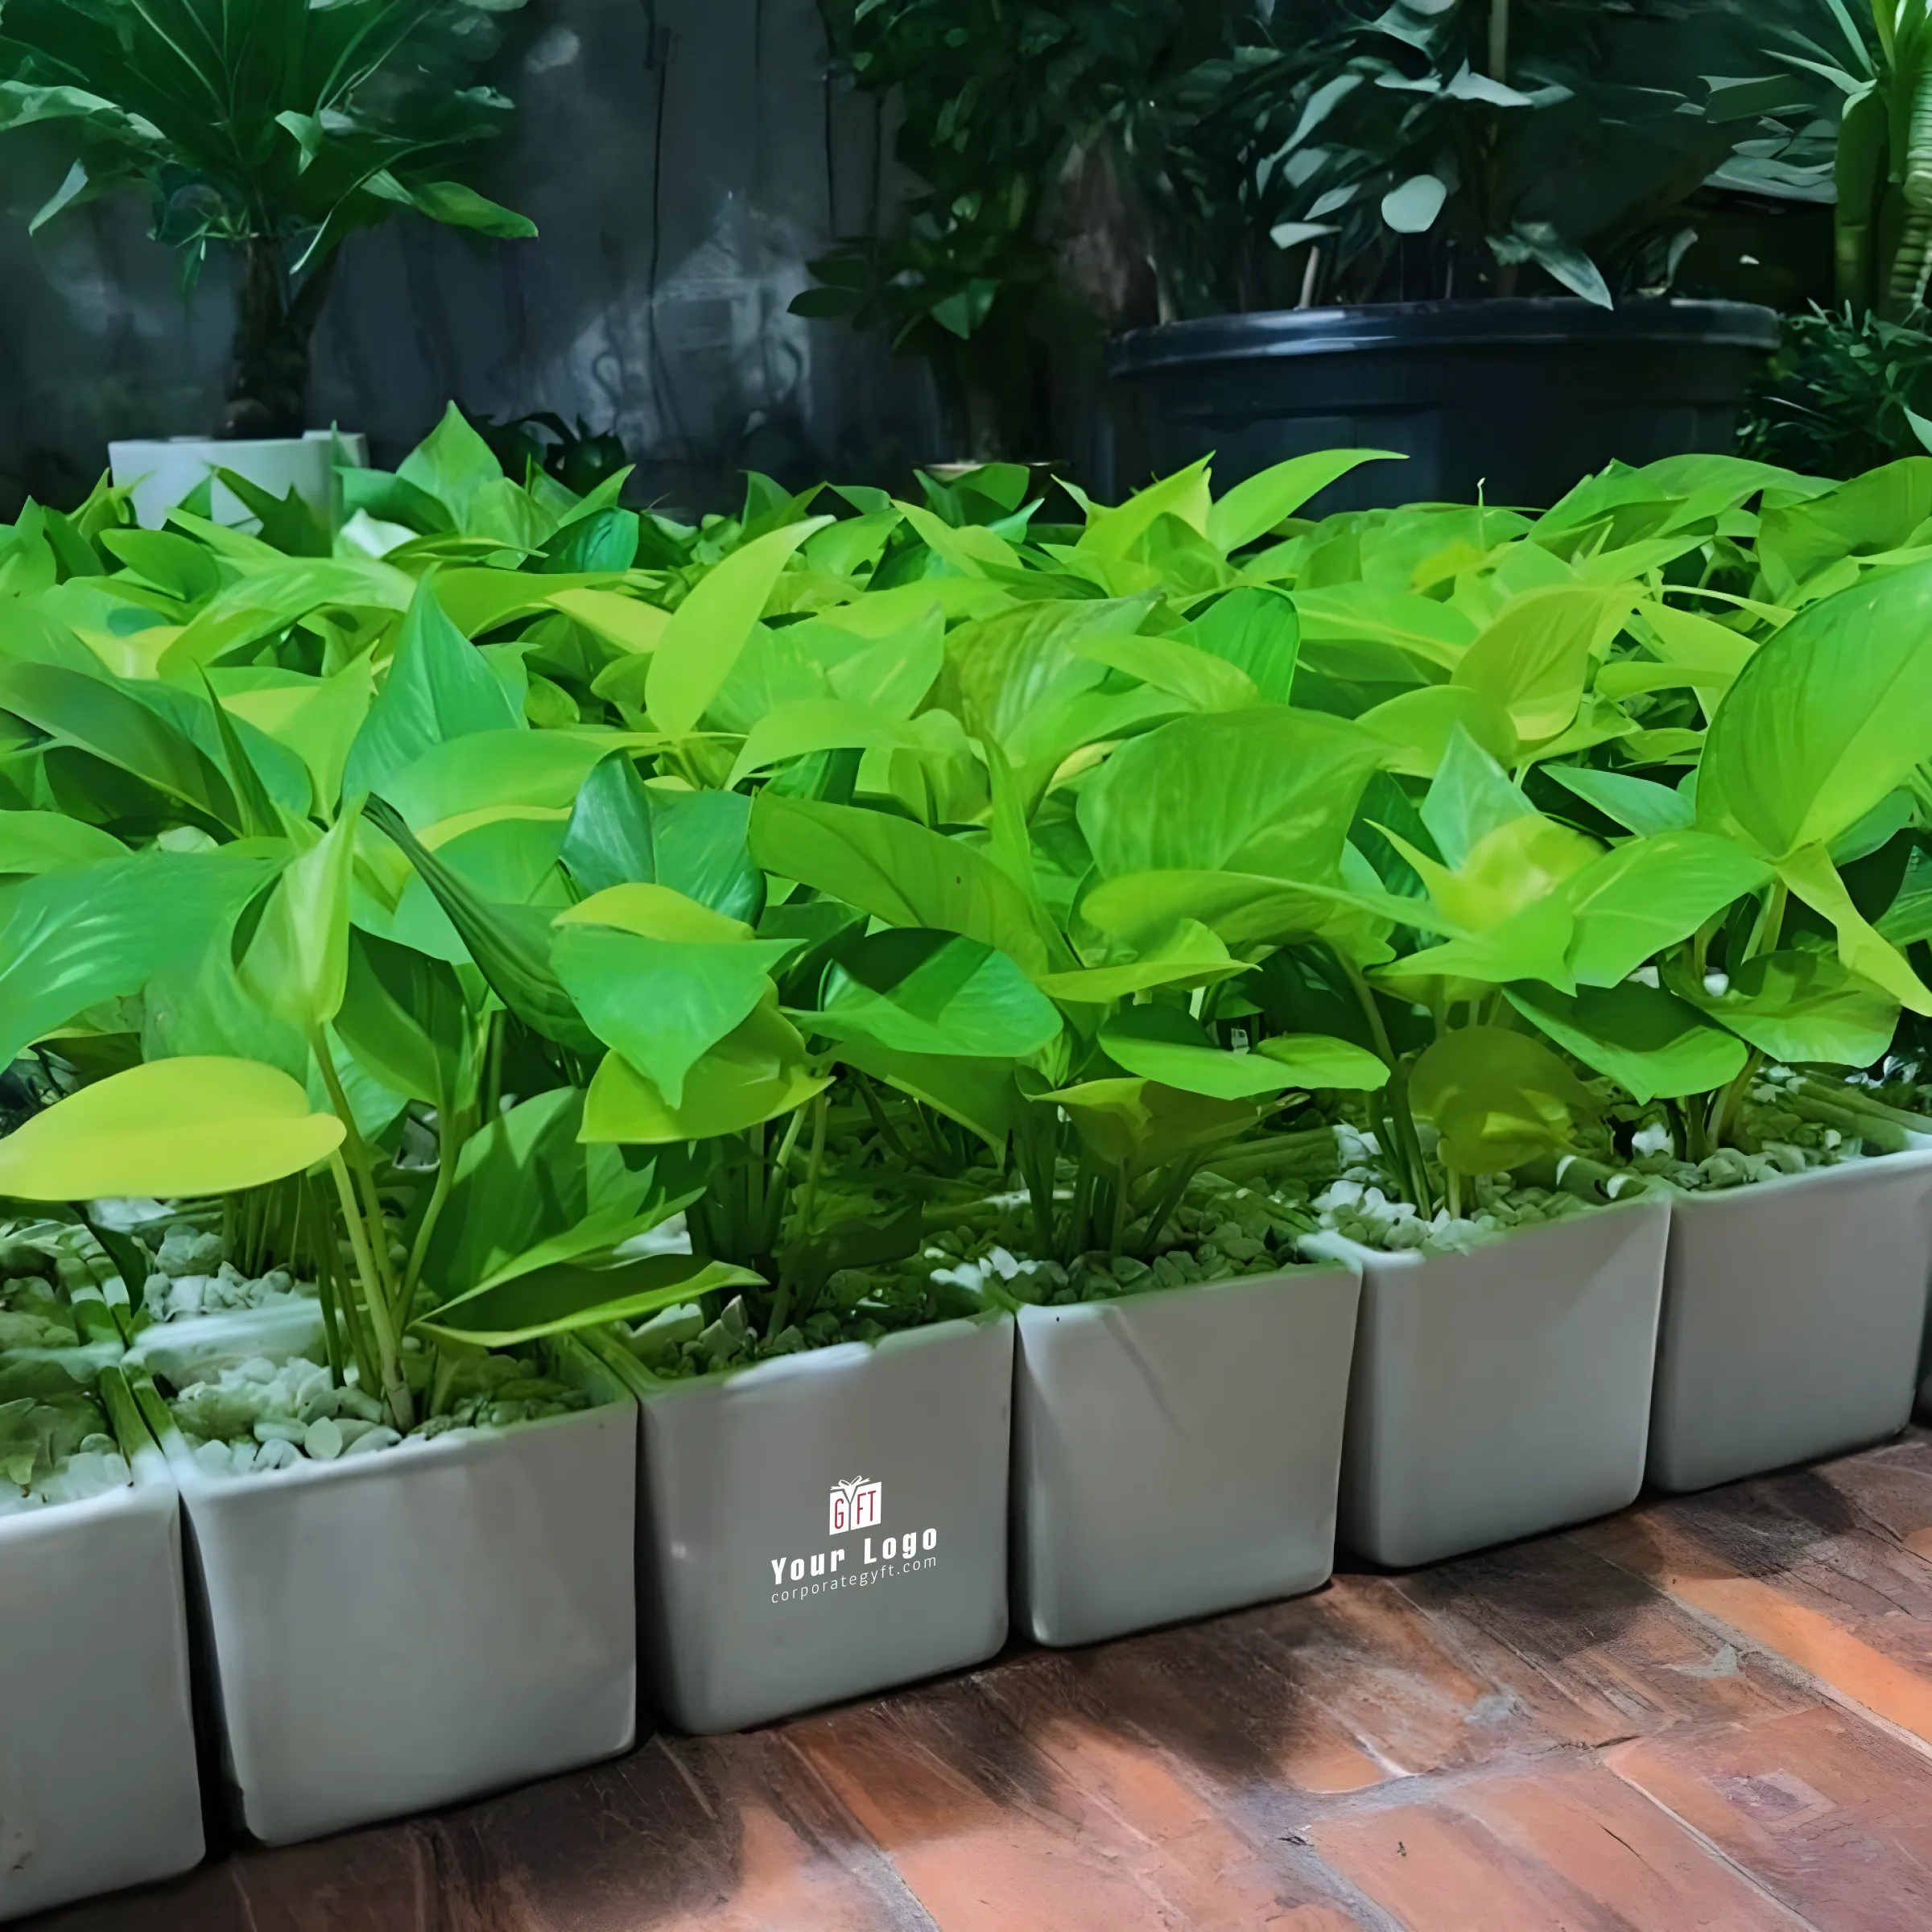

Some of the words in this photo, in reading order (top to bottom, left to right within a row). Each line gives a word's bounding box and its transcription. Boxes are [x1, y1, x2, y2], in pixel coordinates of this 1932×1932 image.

[834, 1487, 877, 1530] GYFT
[770, 1547, 845, 1585] Your
[864, 1528, 937, 1565] Logo
[771, 1556, 936, 1604] corporategyft.com
